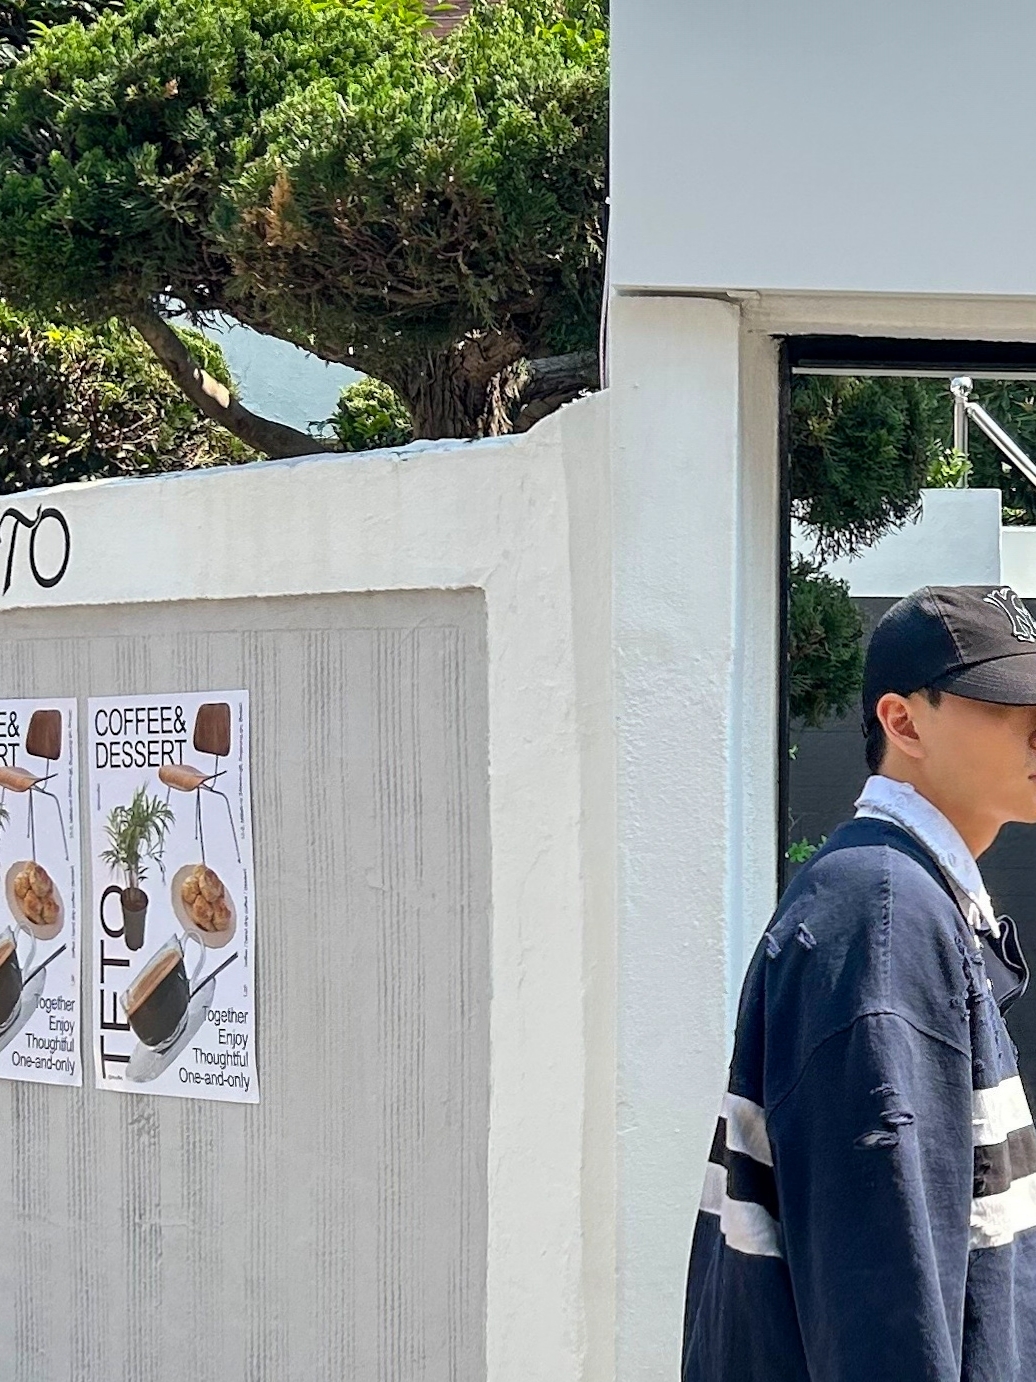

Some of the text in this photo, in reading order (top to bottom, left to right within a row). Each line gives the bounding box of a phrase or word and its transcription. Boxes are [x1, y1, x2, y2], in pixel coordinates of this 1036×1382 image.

[95, 705, 187, 737] COFFEE&
[96, 739, 187, 769] DESSERT
[34, 992, 75, 1013] Together
[49, 1015, 75, 1036] Enjoy
[202, 1005, 248, 1026] Together
[25, 1032, 75, 1055] Thoughtful
[218, 1028, 248, 1050] Enjoy
[11, 1051, 75, 1076] One-and-only
[192, 1047, 249, 1070] Thoughtful
[179, 1067, 250, 1092] One-and-only
